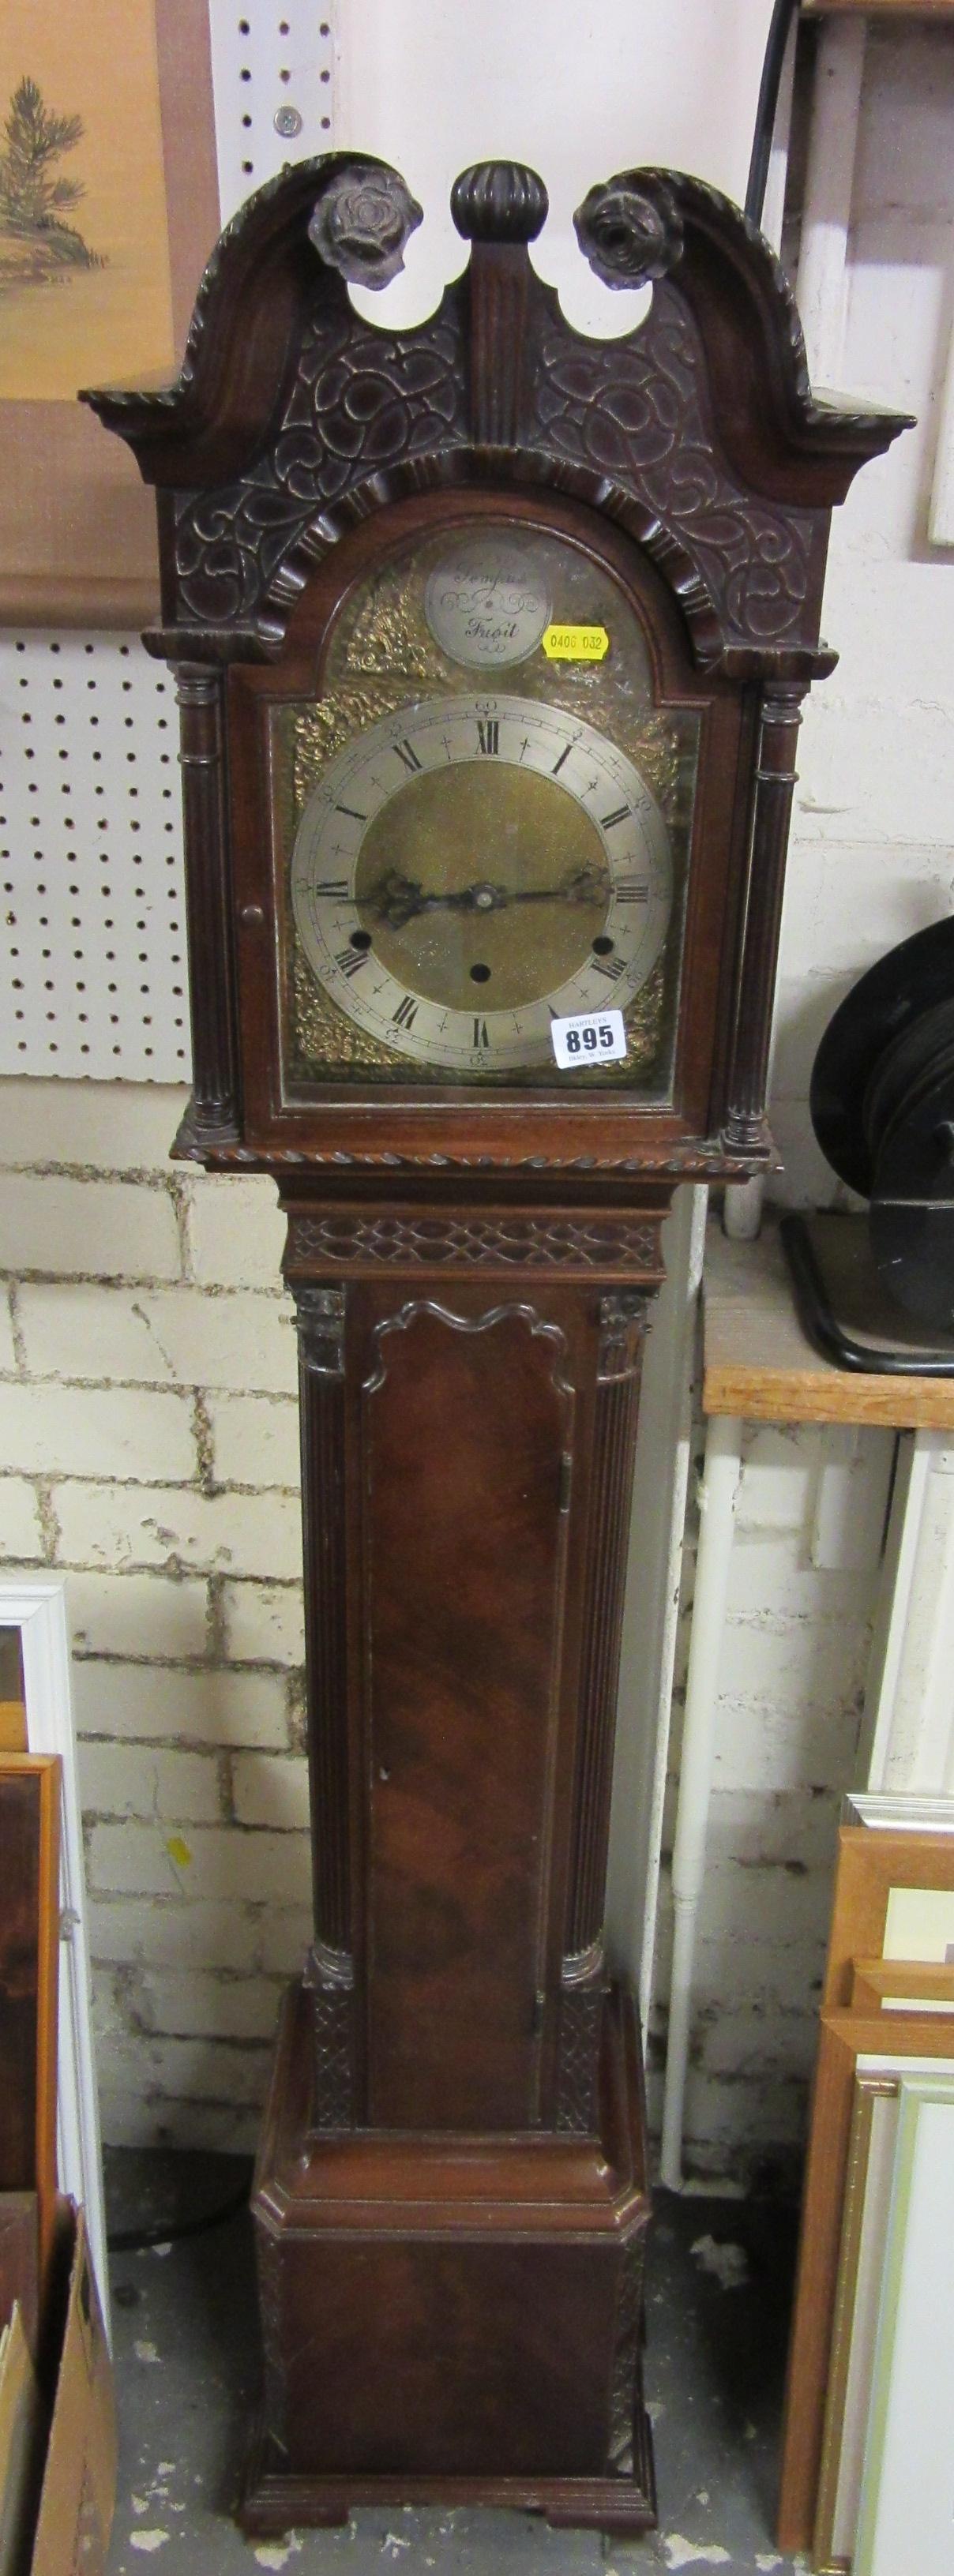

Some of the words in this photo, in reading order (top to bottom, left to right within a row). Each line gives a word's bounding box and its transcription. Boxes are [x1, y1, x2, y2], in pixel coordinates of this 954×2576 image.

[465, 618, 518, 642] Fugit
[550, 635, 577, 648] 0406
[583, 636, 602, 650] 032
[475, 720, 500, 756] XII
[551, 744, 573, 775] I
[600, 804, 633, 830] II
[616, 886, 649, 904] III
[569, 1017, 607, 1029] HARTLEYS
[566, 1025, 614, 1053] 895
